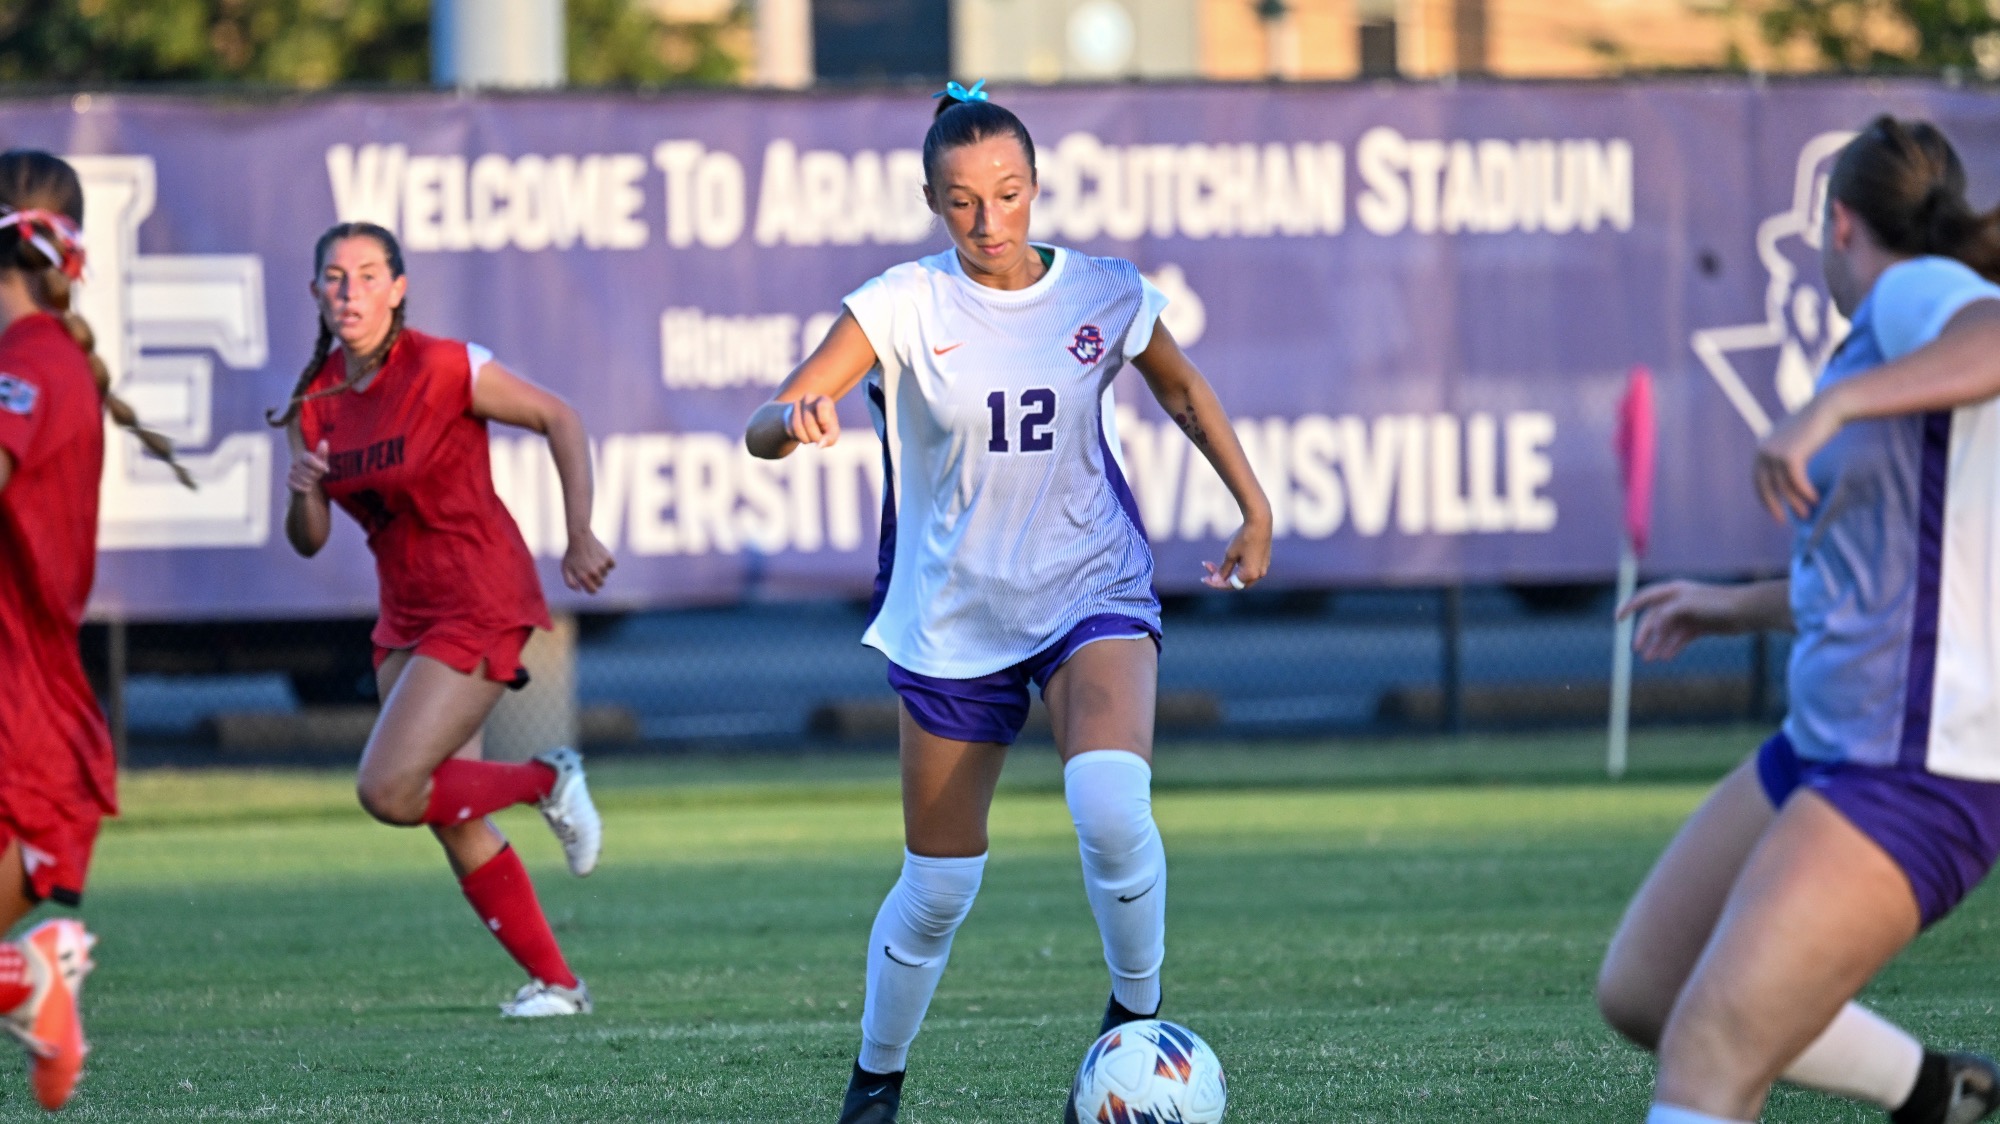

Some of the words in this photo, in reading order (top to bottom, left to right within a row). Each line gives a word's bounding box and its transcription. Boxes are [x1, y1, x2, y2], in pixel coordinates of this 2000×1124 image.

[326, 142, 648, 251] WELCOME
[652, 138, 745, 249] TO
[754, 138, 936, 247] ARAD
[1029, 131, 1345, 241] CCUTCHAN
[1356, 125, 1633, 236] STADIUM
[660, 306, 799, 389] HOME
[986, 387, 1056, 454] 12
[489, 431, 883, 557] NIVERSIT
[1116, 405, 1557, 541] VANSVILLE
